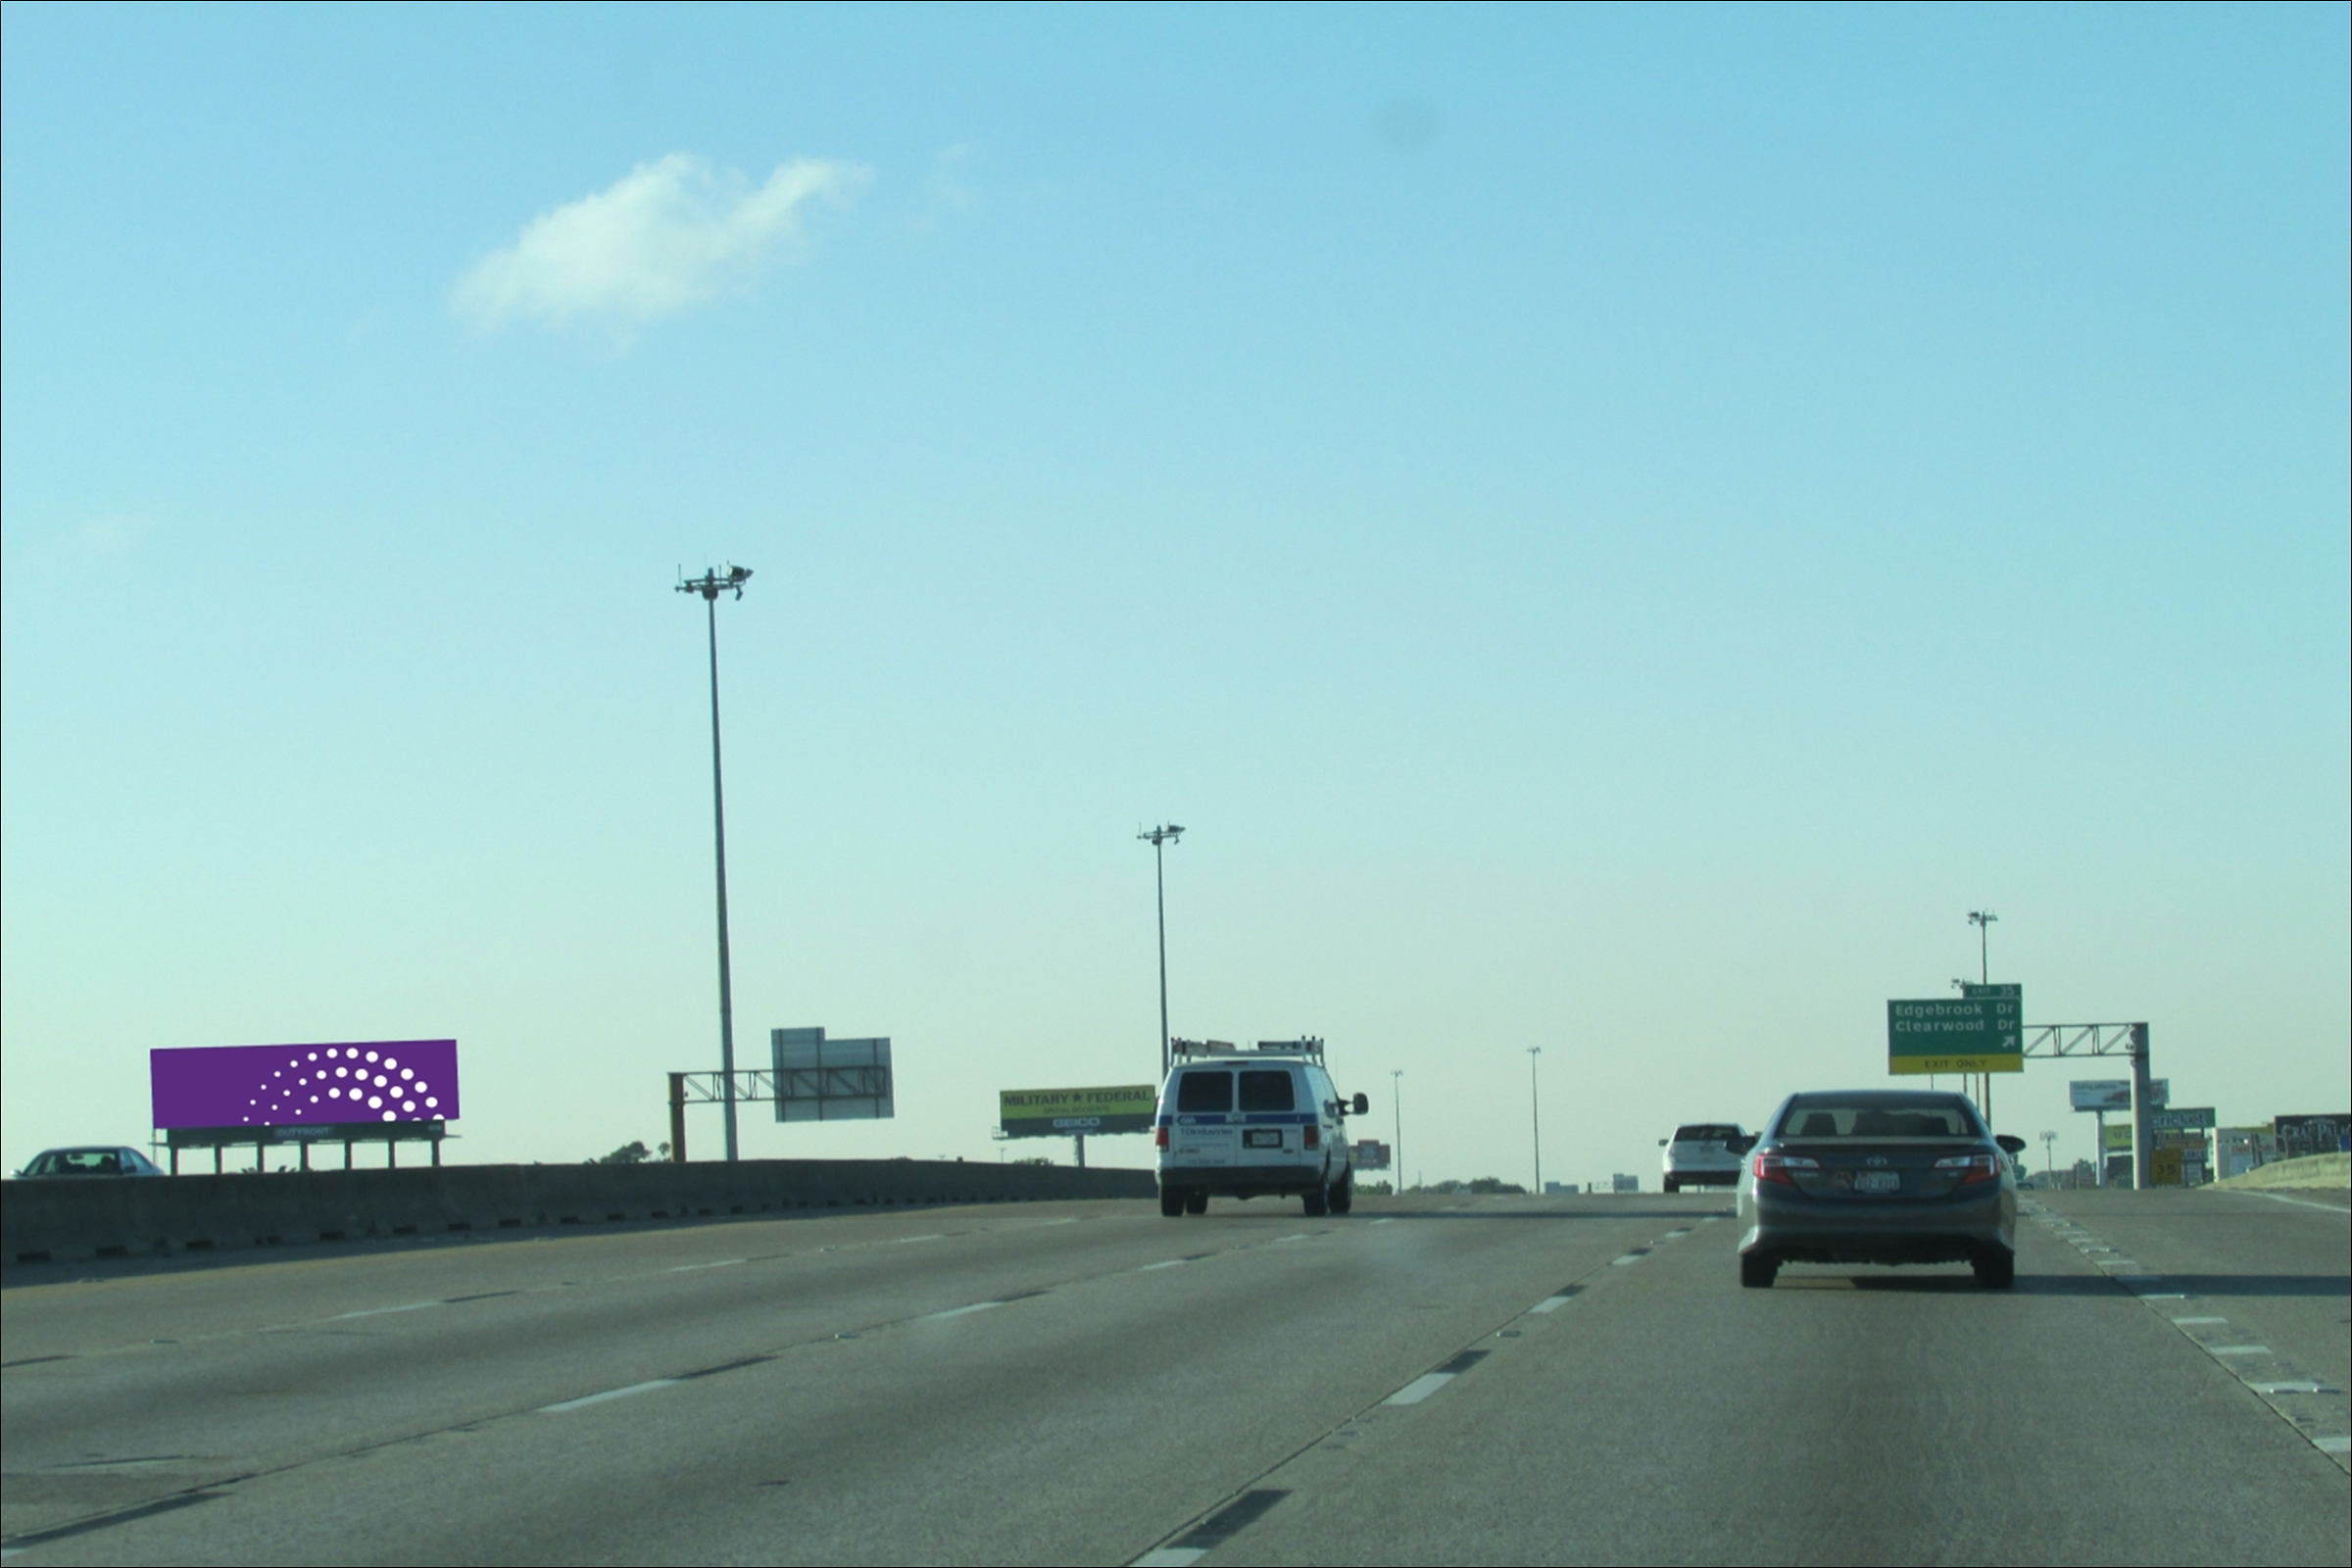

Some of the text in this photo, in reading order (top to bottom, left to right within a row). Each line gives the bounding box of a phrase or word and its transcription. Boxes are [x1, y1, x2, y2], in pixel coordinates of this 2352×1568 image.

[1972, 985, 2015, 997] EXIT 35
[1895, 1003, 2015, 1018] Edgebrook Dr
[1895, 1019, 2015, 1032] Clearwood Dr
[1924, 1059, 1988, 1069] EXIT ONLY
[1004, 1090, 1151, 1106] MILITARY FEDERAL
[1053, 1117, 1101, 1128] GEICO
[2151, 1110, 2207, 1127] cricket
[276, 1127, 329, 1137] OUTFRONT
[2156, 1162, 2177, 1176] 35
